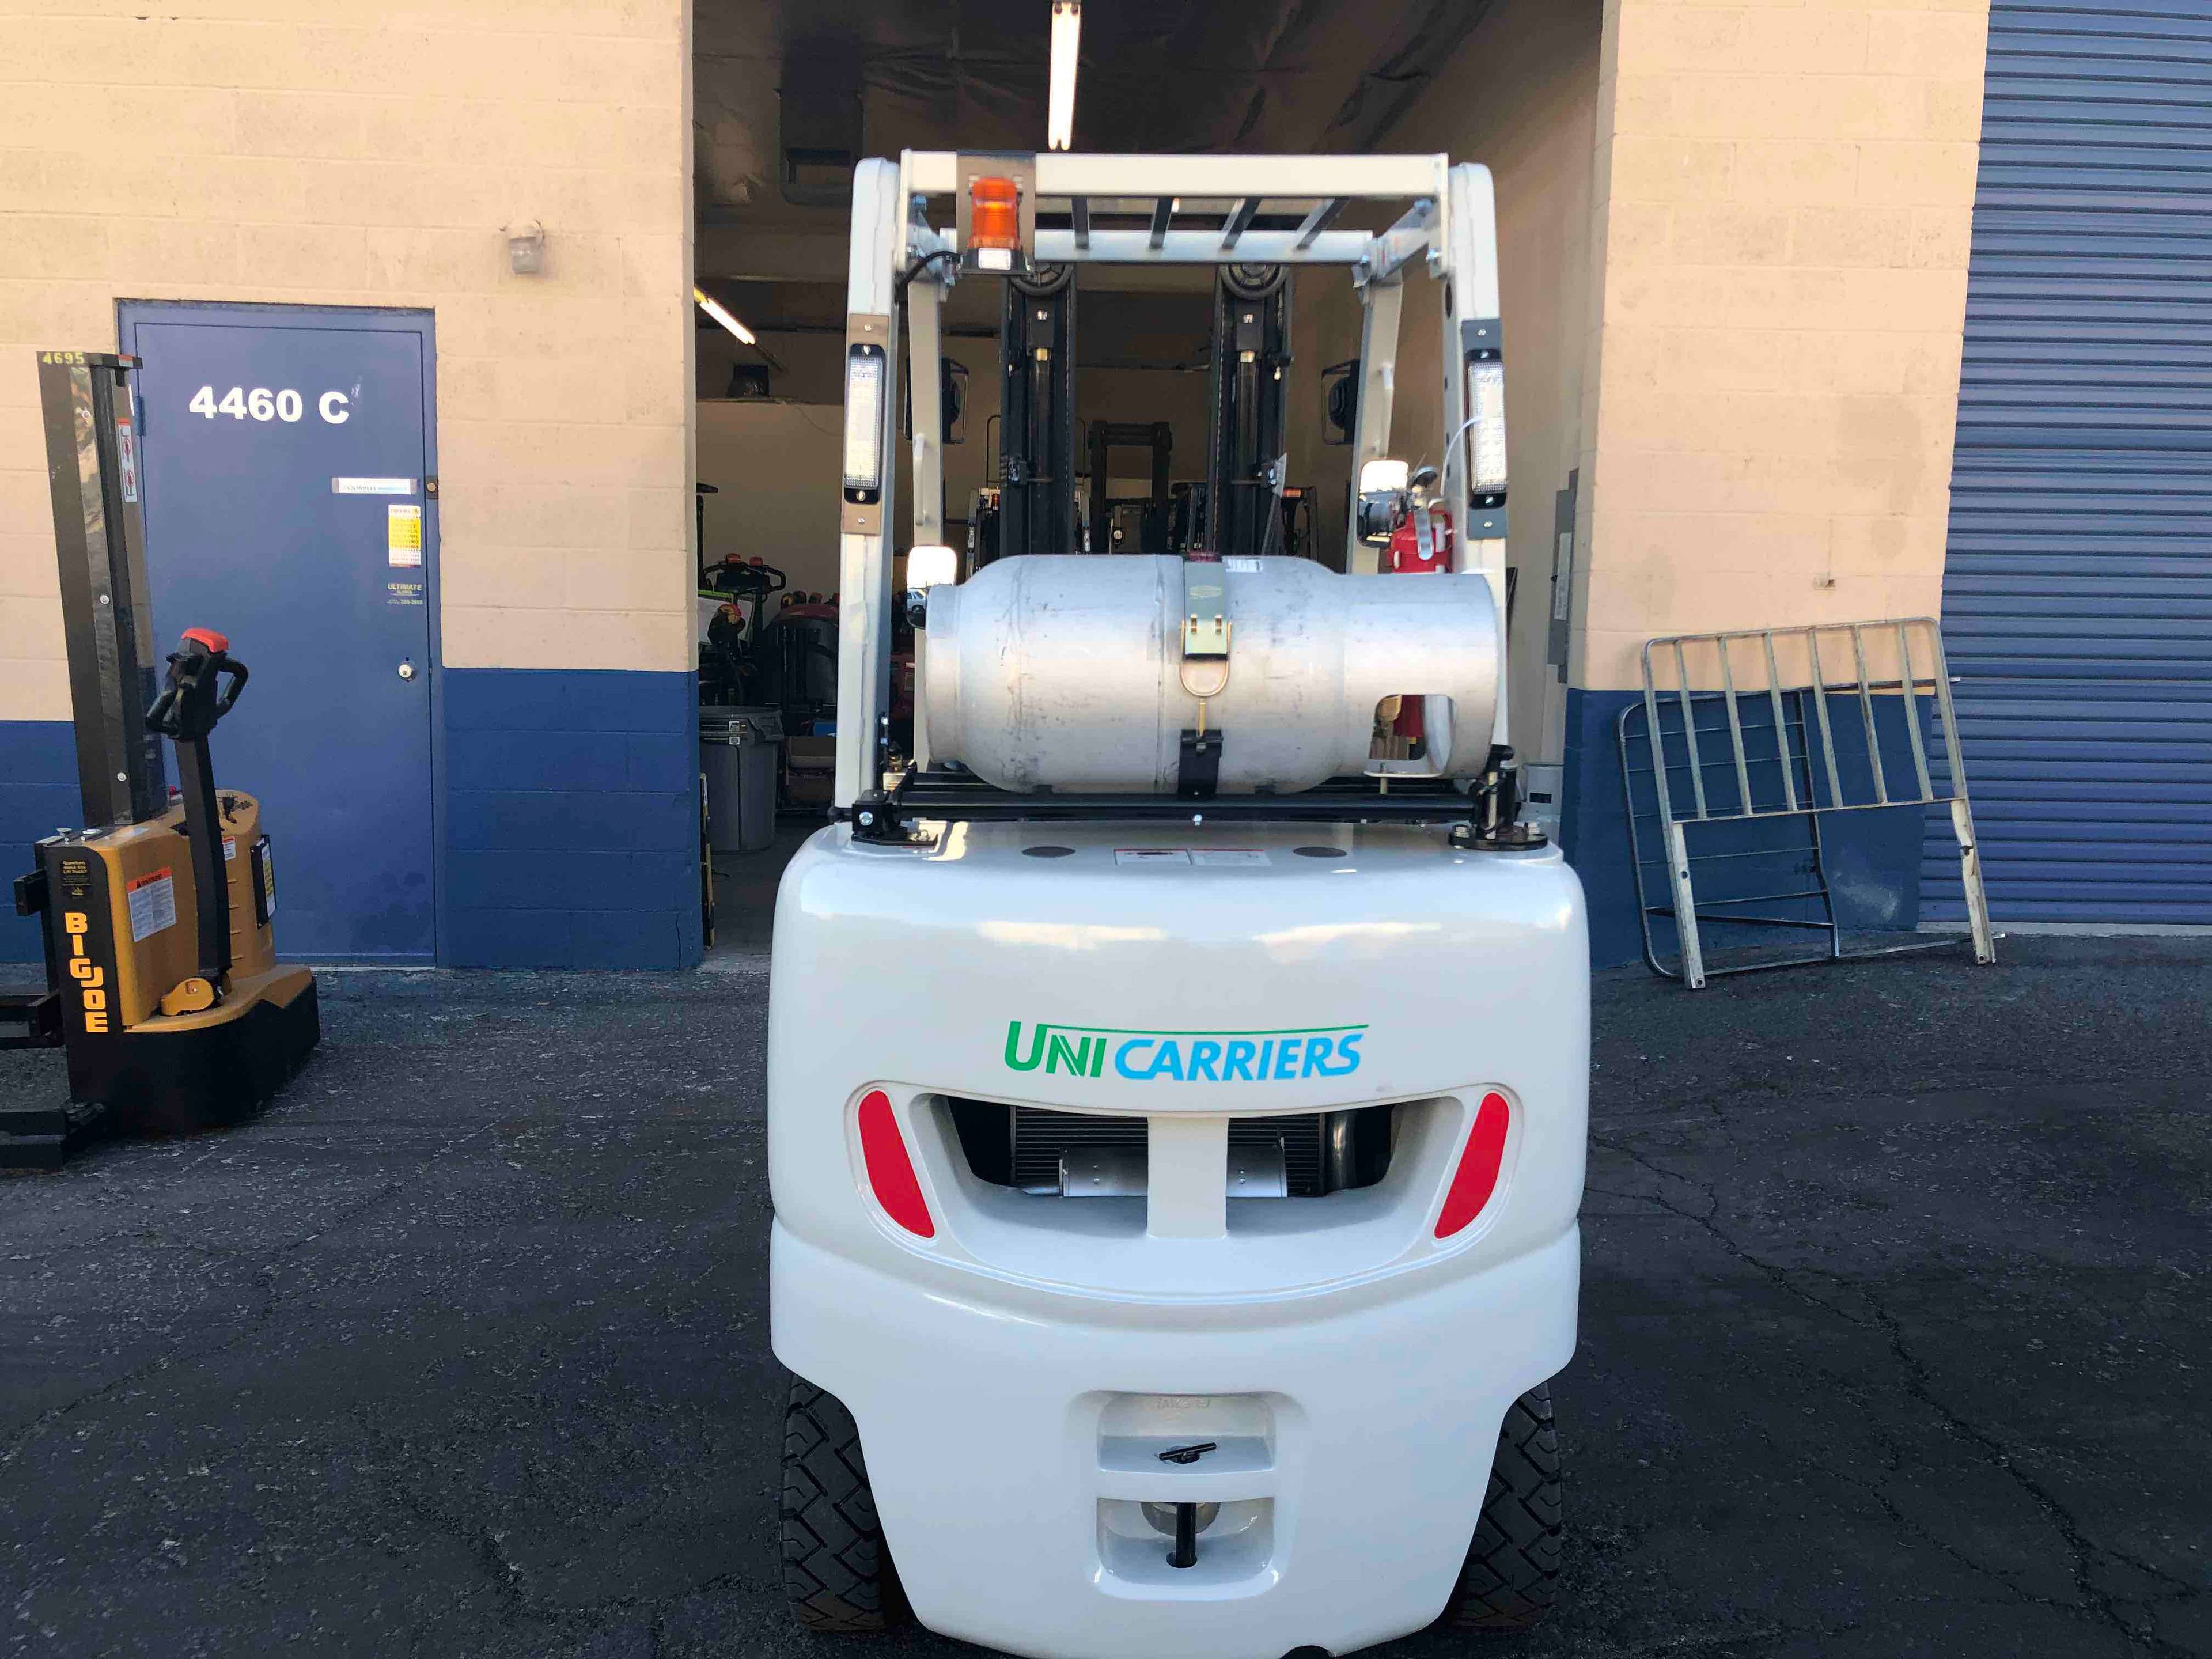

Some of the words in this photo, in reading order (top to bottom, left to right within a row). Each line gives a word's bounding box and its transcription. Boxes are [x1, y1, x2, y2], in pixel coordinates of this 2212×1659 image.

[42, 351, 85, 365] 4695
[189, 386, 302, 422] 4460
[319, 391, 350, 424] C
